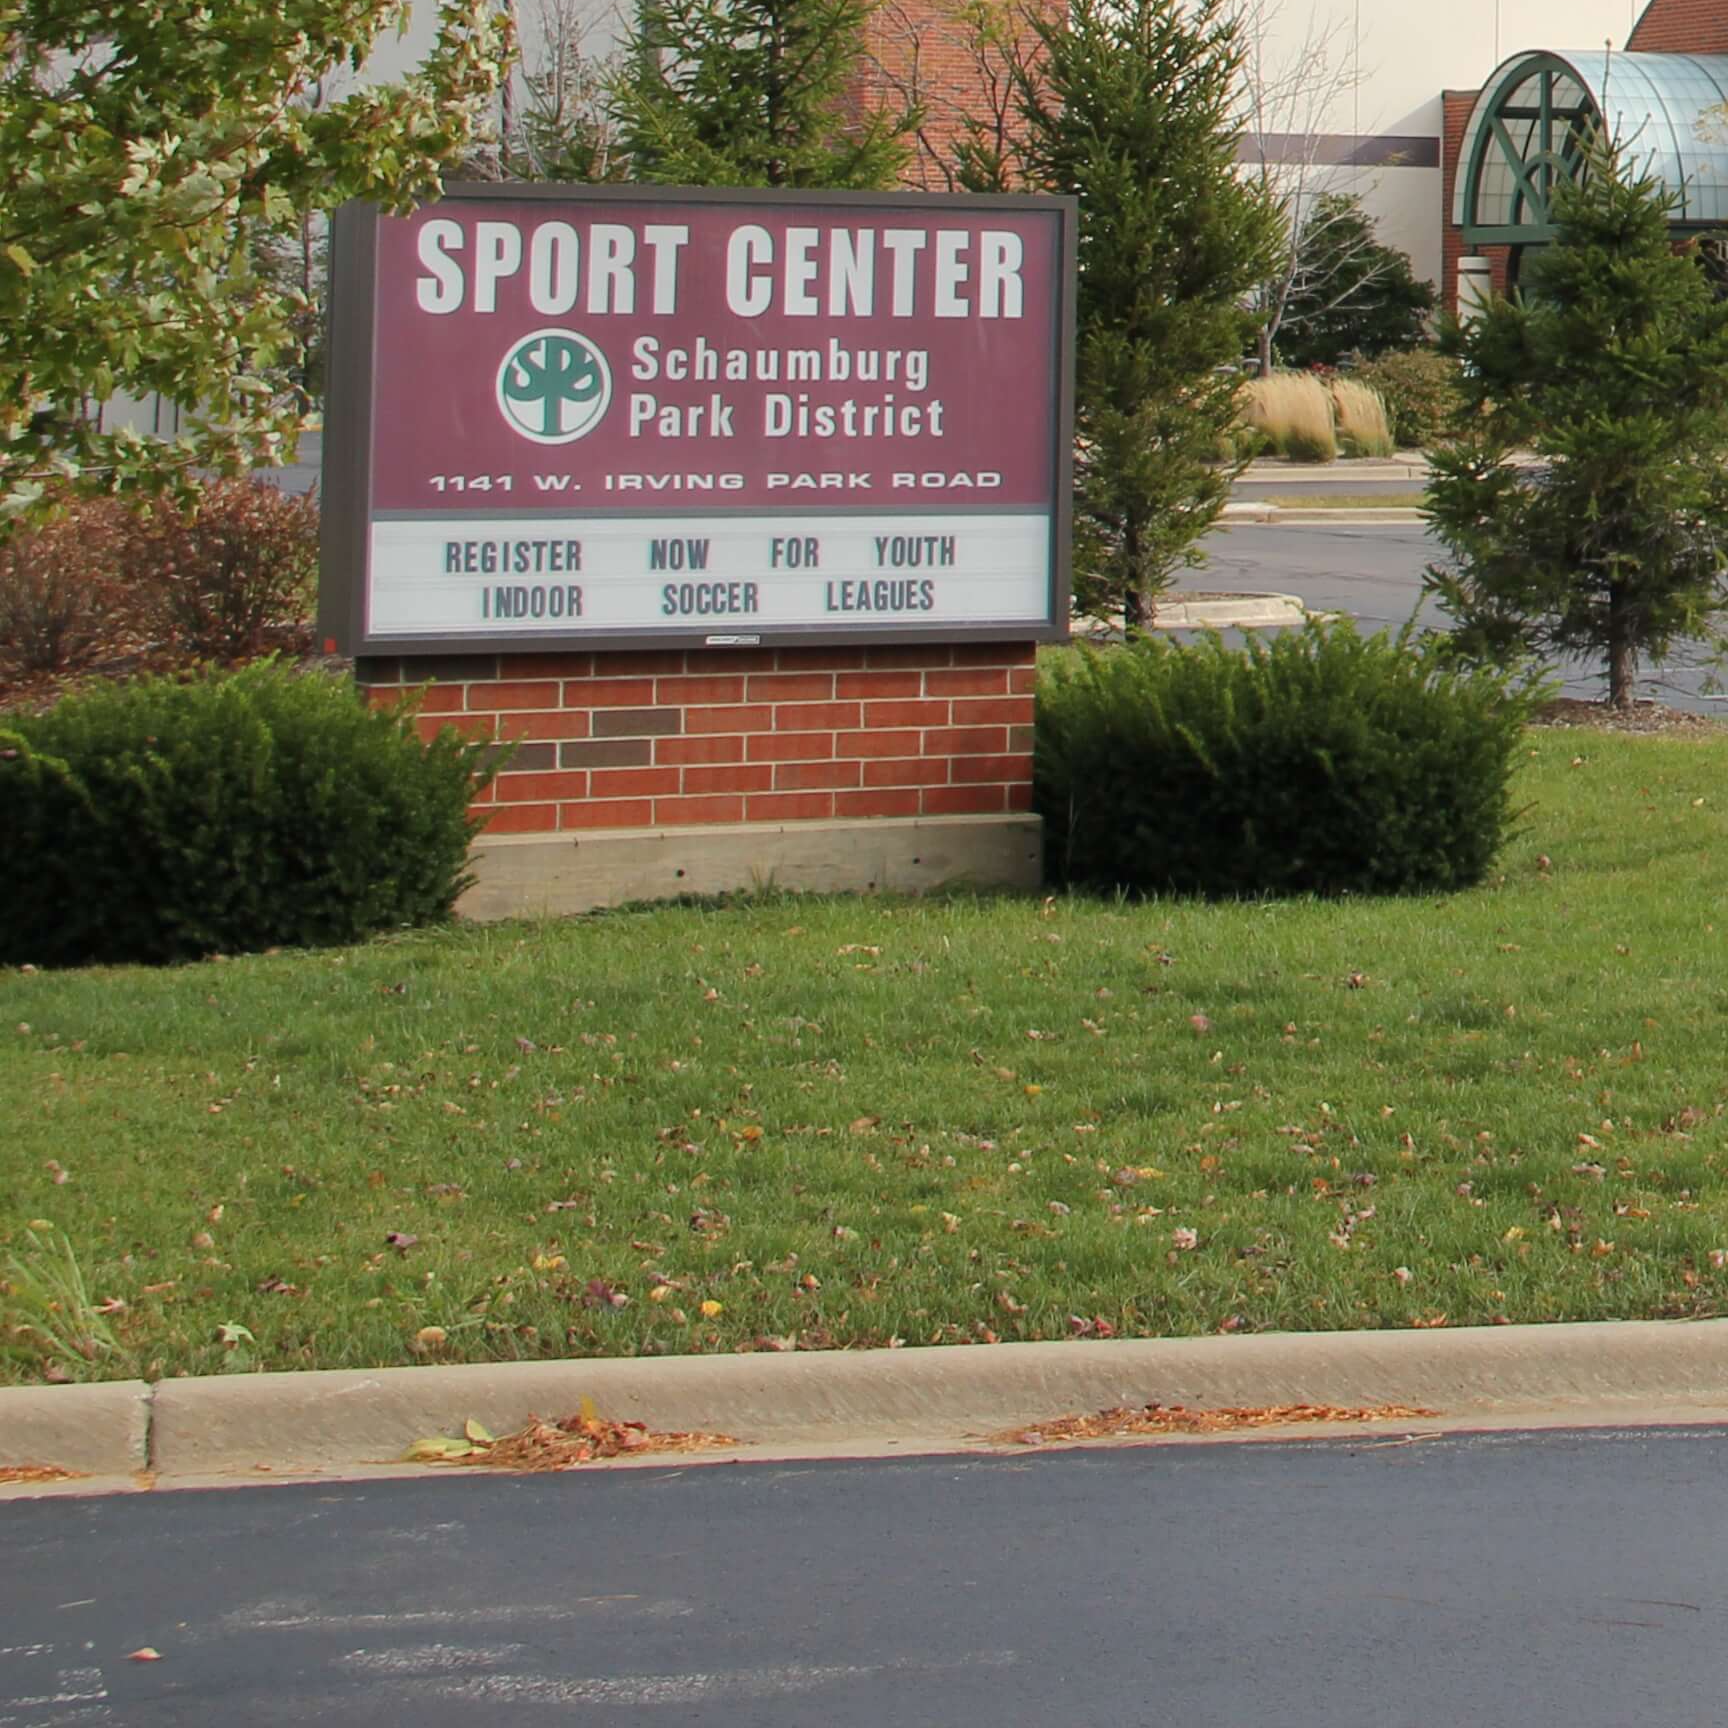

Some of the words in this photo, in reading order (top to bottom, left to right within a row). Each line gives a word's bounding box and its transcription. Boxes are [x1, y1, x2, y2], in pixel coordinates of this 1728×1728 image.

[417, 220, 688, 314] SPORT
[727, 225, 1022, 317] CENTER
[632, 337, 927, 390] Schaumburg
[630, 394, 733, 436] Park
[765, 392, 942, 436] District
[428, 474, 513, 492] 1141
[533, 474, 582, 492] W.
[605, 473, 745, 491] IRVING
[767, 472, 872, 490] PARK
[892, 471, 1002, 489] ROAD
[446, 540, 581, 573] REGISTER
[650, 539, 710, 570] NOW
[772, 537, 819, 568] FOR
[874, 536, 955, 567] YOUTH
[483, 585, 583, 618] INDOOR
[662, 582, 758, 615] SOCCER
[827, 579, 934, 611] LEAGUES
